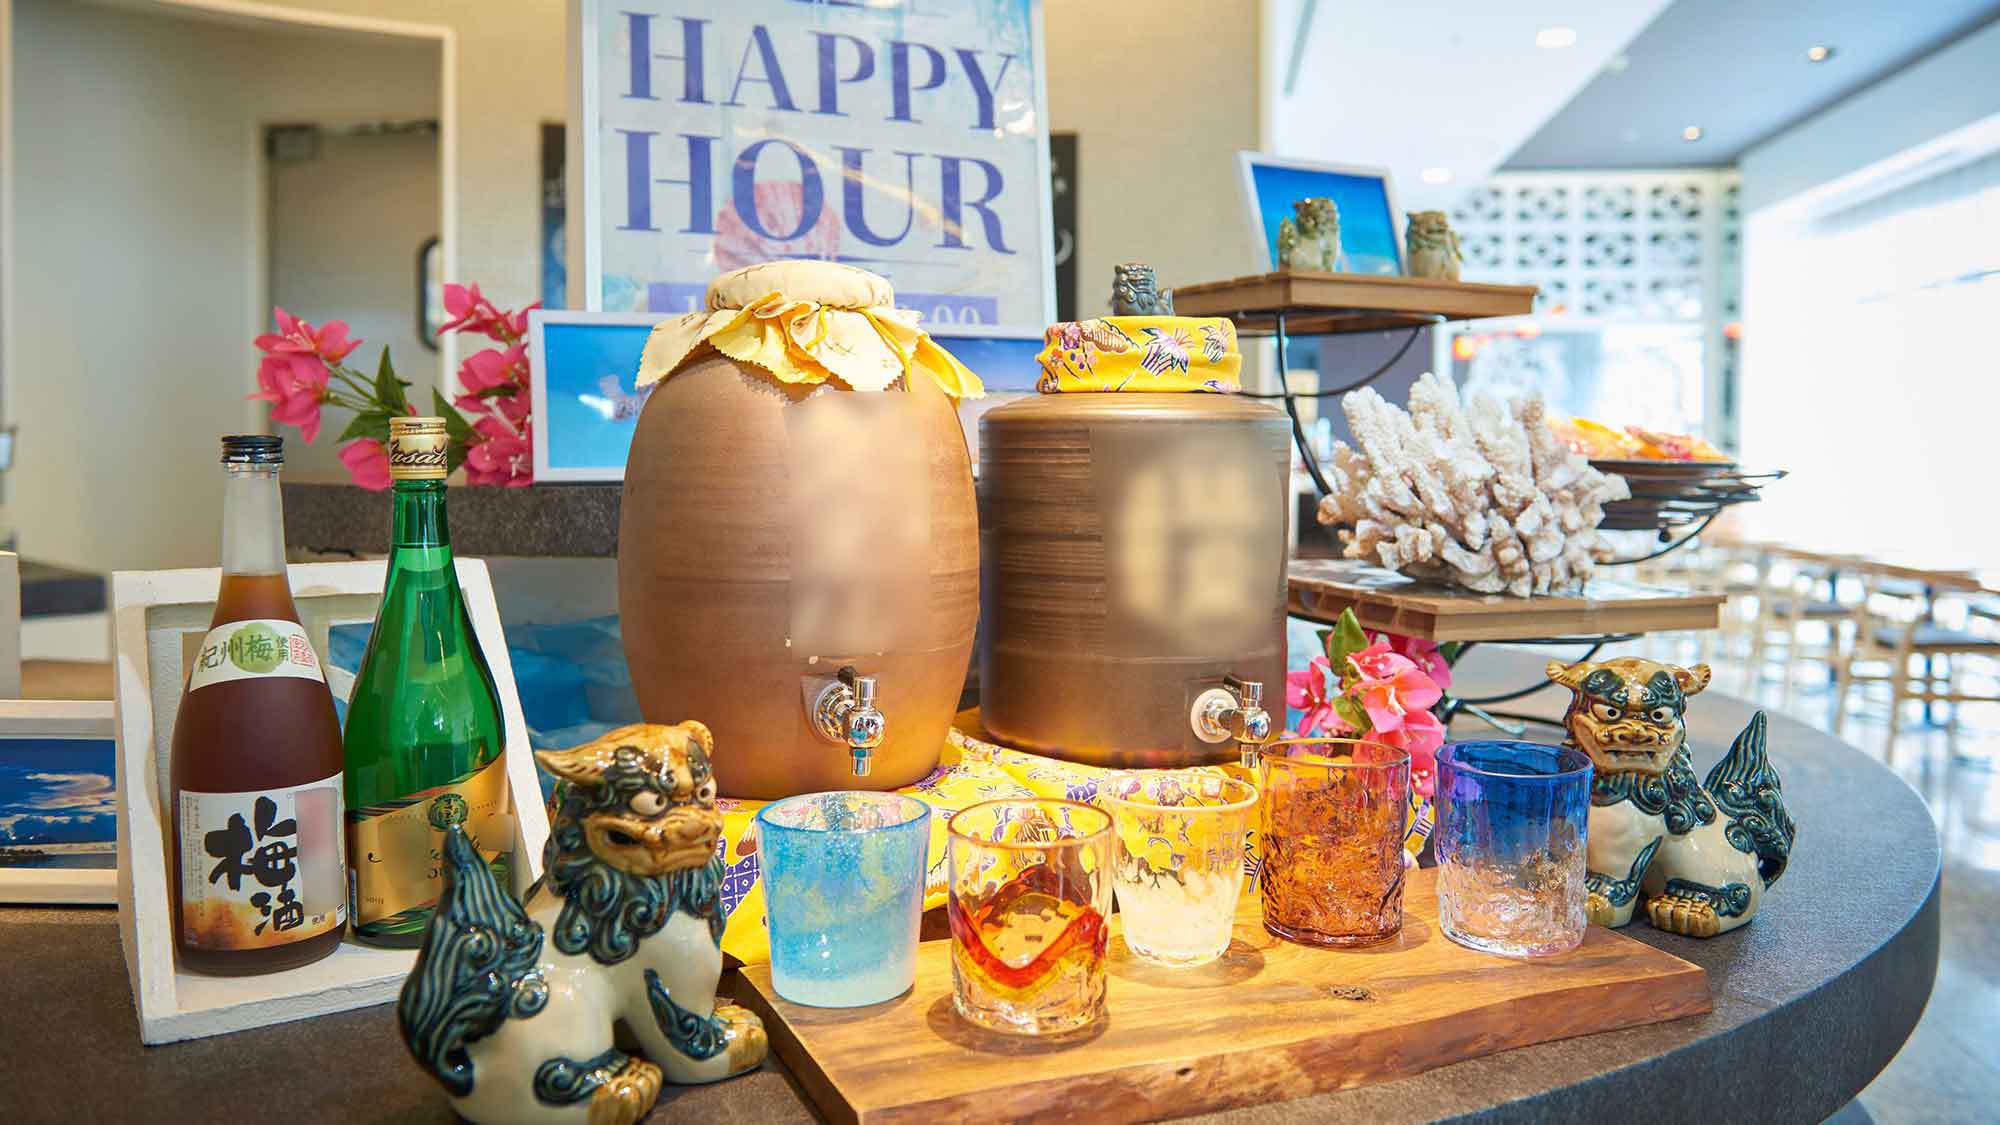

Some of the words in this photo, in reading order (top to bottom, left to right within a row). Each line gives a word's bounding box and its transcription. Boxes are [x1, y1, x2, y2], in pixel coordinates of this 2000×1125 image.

[620, 12, 1017, 130] HAPPY
[616, 129, 1017, 254] HOUR
[205, 796, 304, 936] 梅酒
